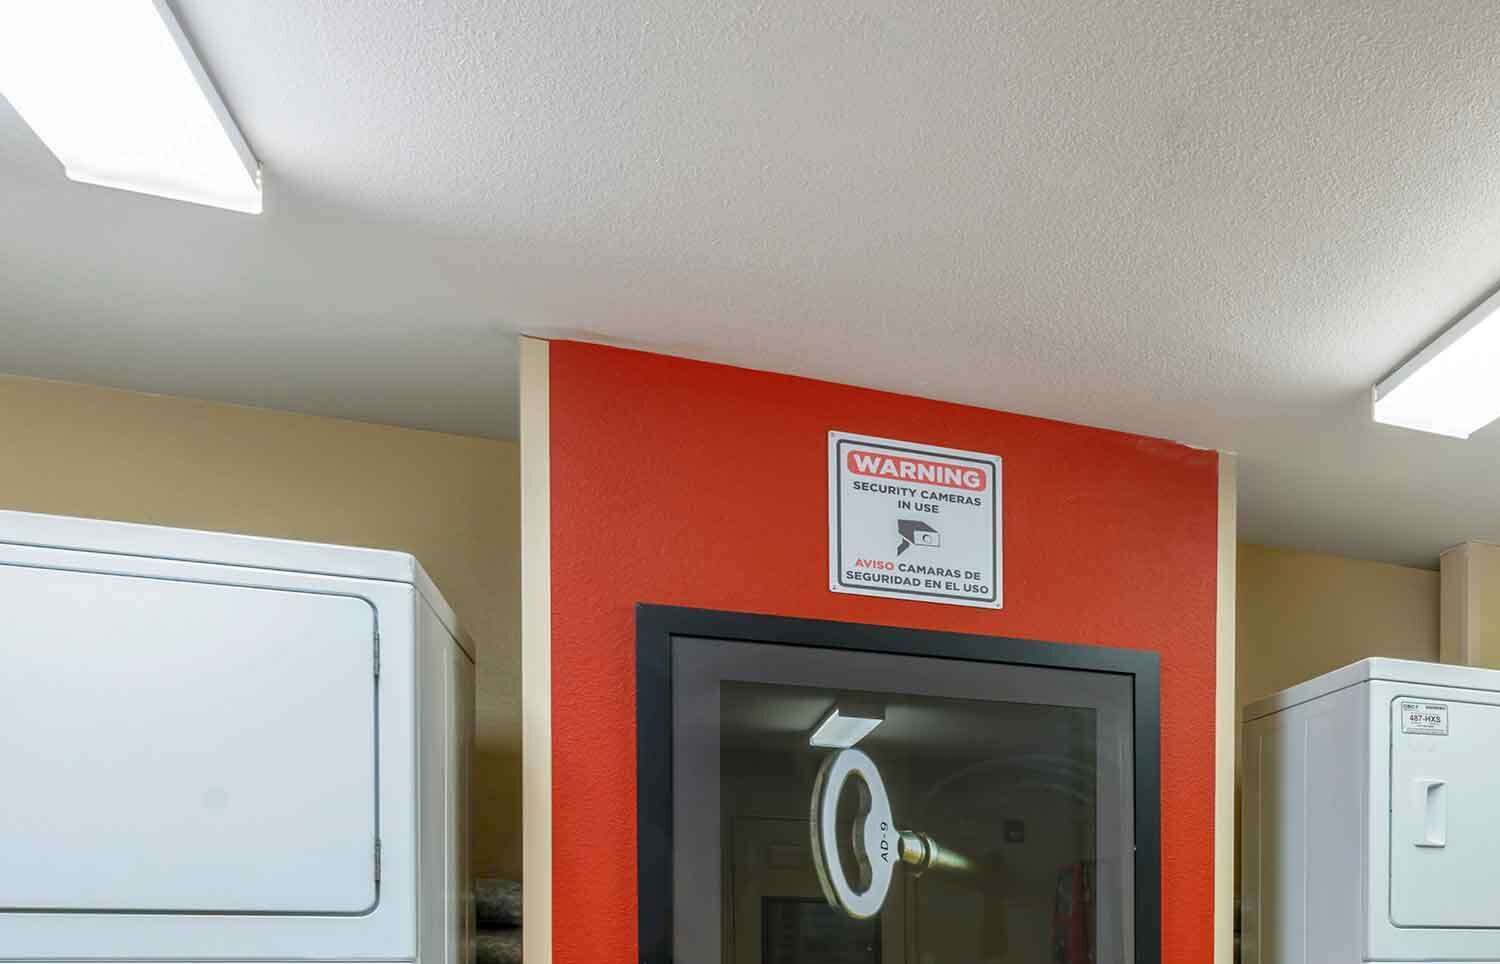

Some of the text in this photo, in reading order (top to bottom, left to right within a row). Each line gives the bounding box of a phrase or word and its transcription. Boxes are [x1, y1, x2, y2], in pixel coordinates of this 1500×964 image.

[853, 453, 980, 487] WARNING
[853, 481, 982, 506] SECURITY CAMERAS
[898, 500, 940, 513] IN USE
[855, 558, 981, 581] AVISO CAMARAS DE
[846, 570, 989, 594] SEGURIDAD EN EL USO
[880, 821, 889, 863] AD-9
